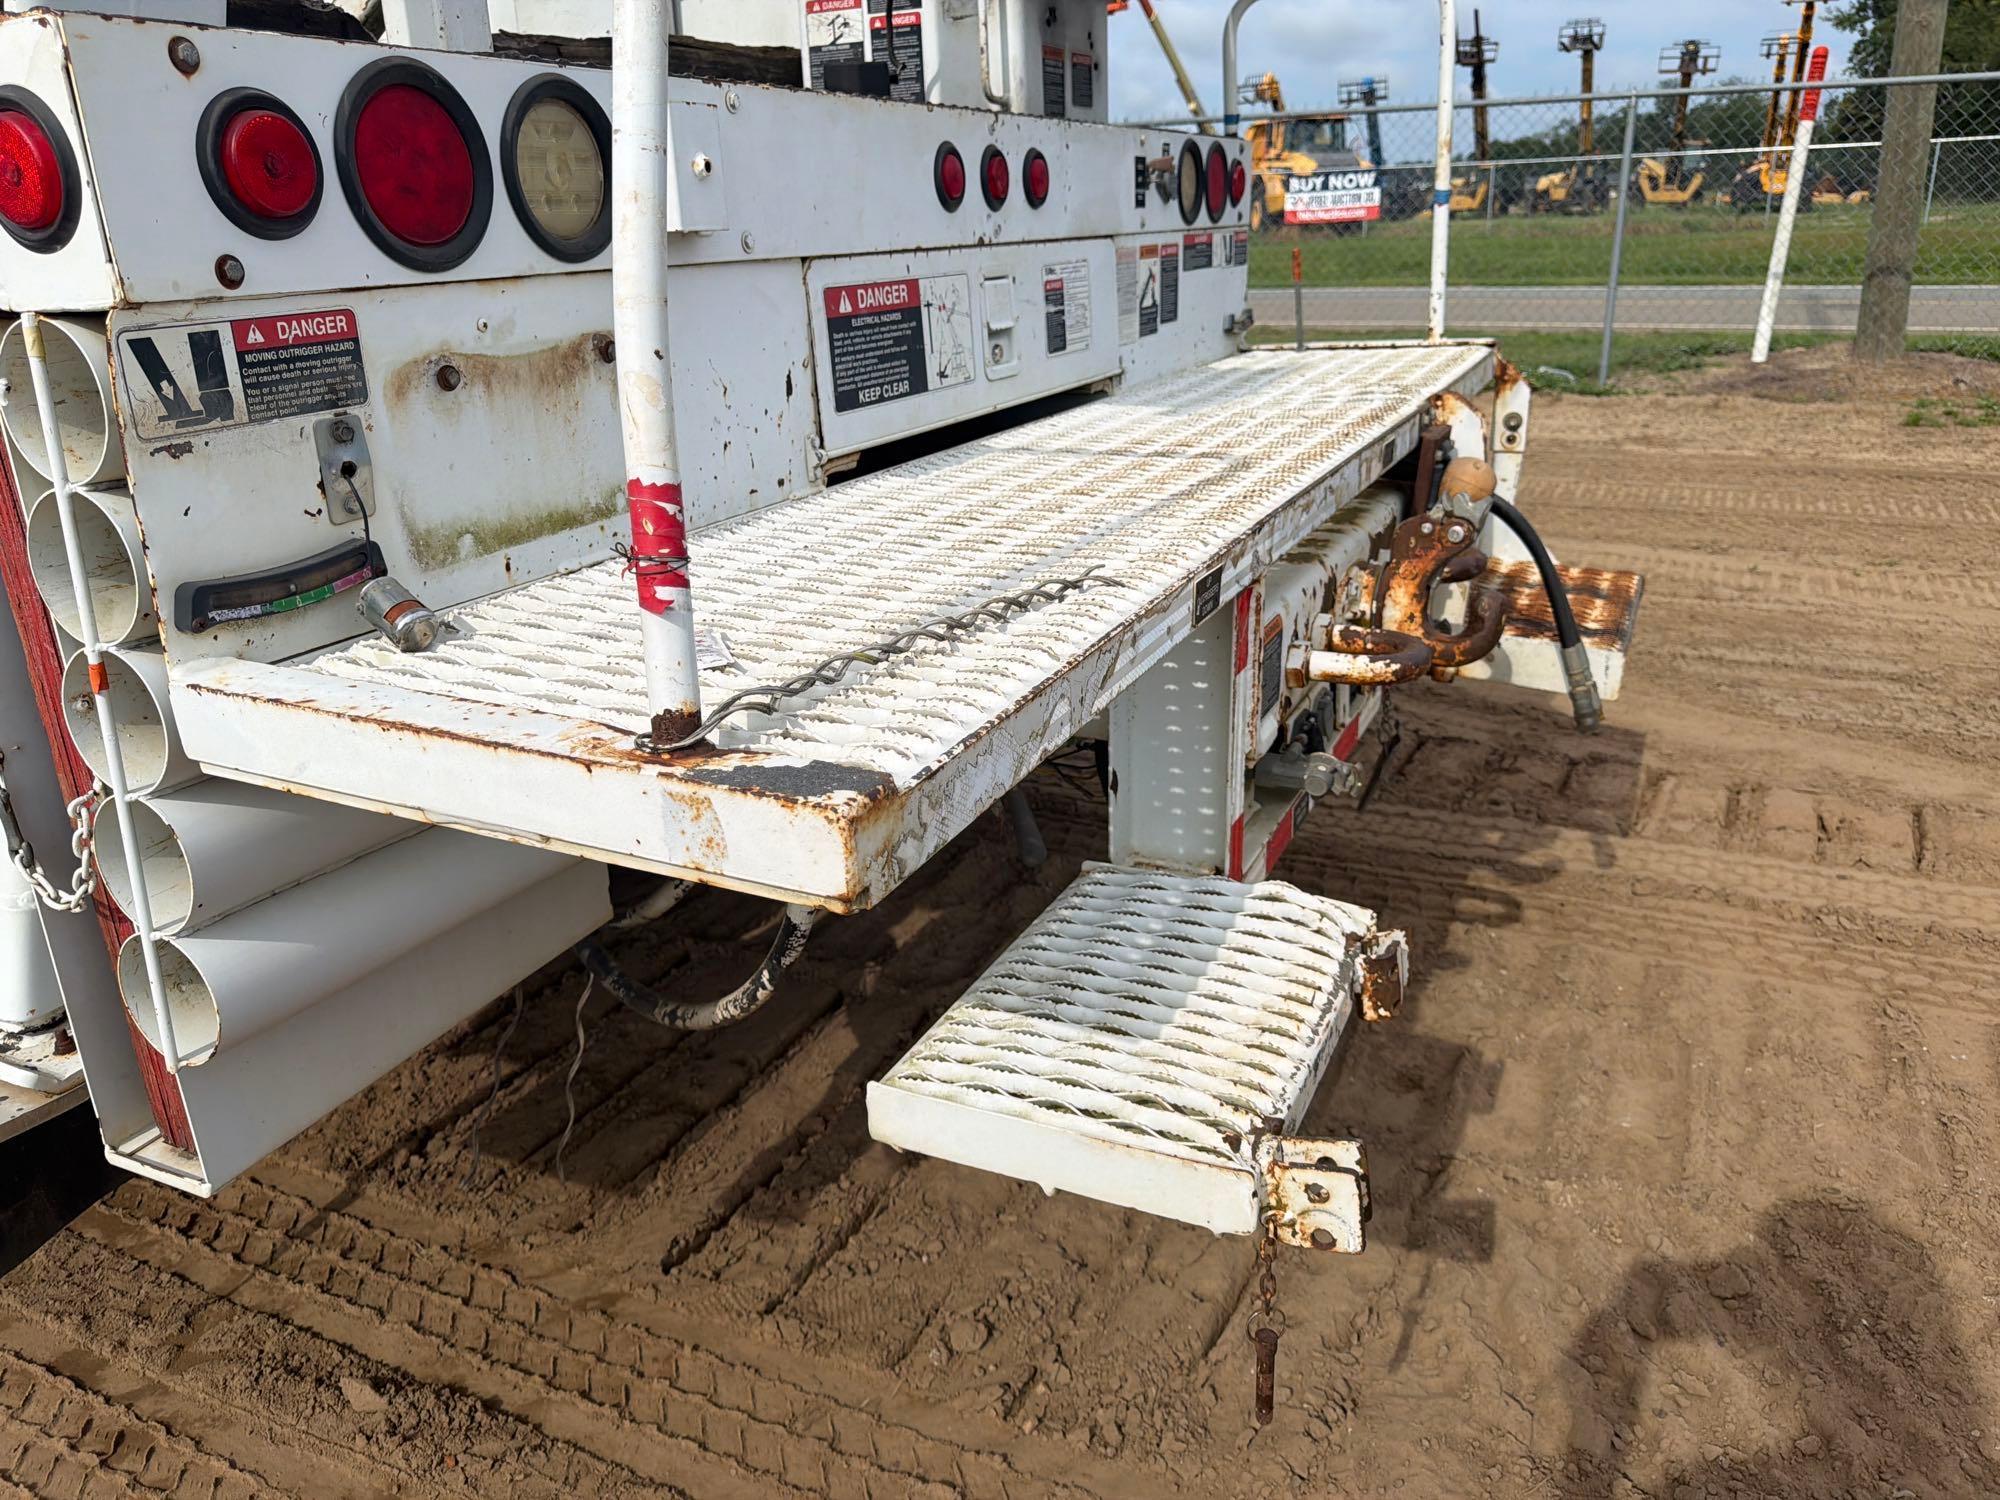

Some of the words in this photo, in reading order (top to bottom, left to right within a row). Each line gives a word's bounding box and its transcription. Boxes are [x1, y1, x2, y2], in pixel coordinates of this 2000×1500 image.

[1289, 175, 1325, 193] BUY
[1328, 171, 1377, 191] NOW
[857, 284, 909, 309] DANGER
[276, 315, 348, 340] DANGER
[245, 351, 277, 363] MOVING
[280, 345, 323, 359] OUTRIGGER
[325, 341, 355, 353] HAZARD
[242, 366, 271, 376] Contact
[273, 364, 288, 372] with
[295, 360, 320, 370] moving
[323, 355, 352, 365] outrigger
[244, 376, 257, 384] will
[259, 374, 280, 382] cause
[282, 371, 302, 379] death
[312, 366, 337, 375] serious
[246, 388, 260, 396] You
[278, 381, 300, 392] signal
[301, 378, 326, 390] person
[326, 376, 342, 384] must
[858, 386, 882, 404] KEEP
[883, 380, 910, 398] CLEAR
[248, 396, 262, 404] that
[263, 391, 297, 403] personnel
[249, 404, 268, 412] clear
[278, 400, 290, 408] the
[291, 394, 322, 406] outrigger
[250, 410, 279, 420] contact
